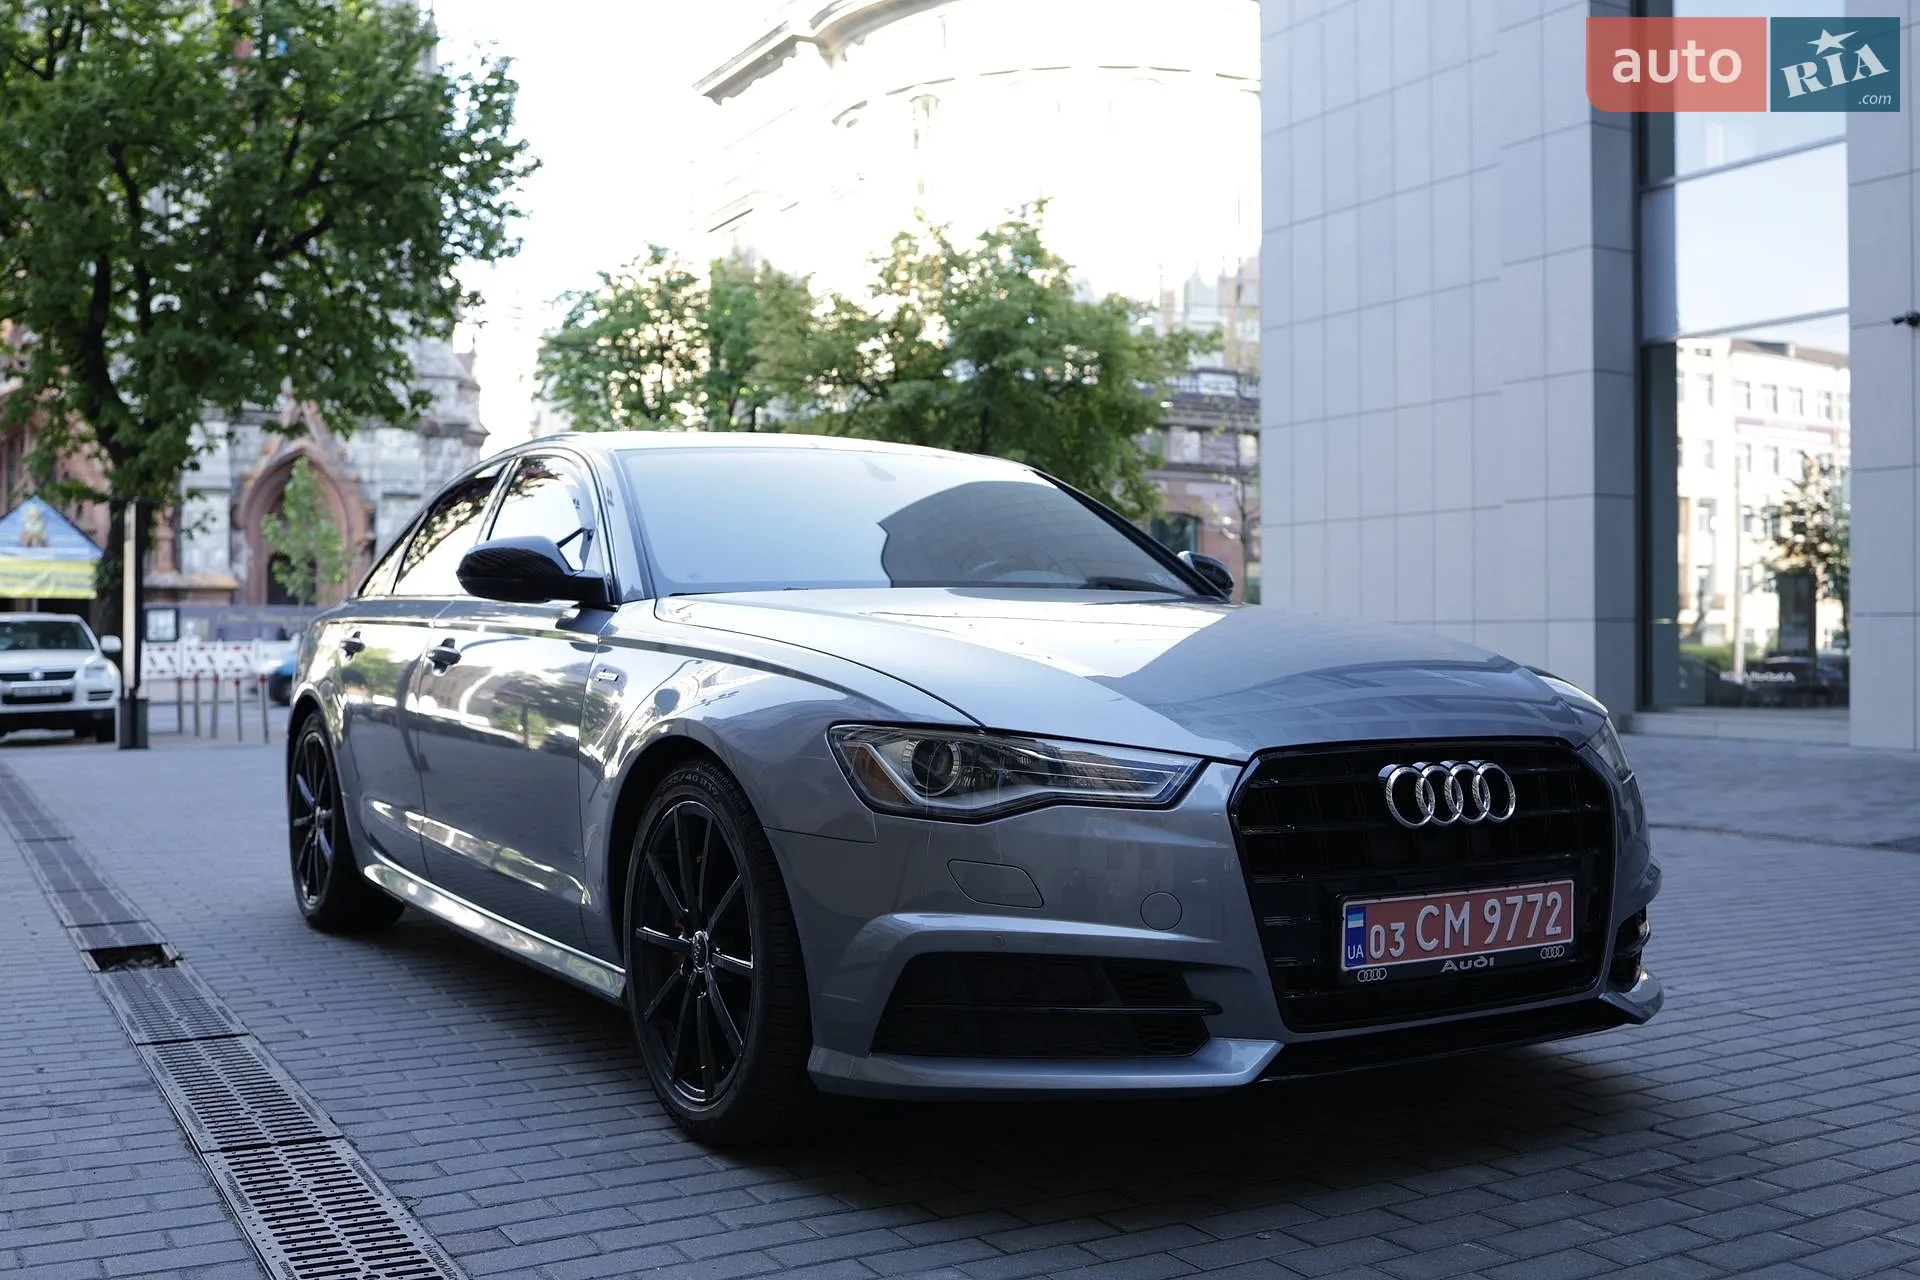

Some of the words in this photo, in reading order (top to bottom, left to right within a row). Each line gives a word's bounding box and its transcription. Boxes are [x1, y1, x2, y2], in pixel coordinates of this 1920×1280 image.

[1369, 922, 1406, 960] 03
[1415, 901, 1471, 951] CM
[1483, 891, 1562, 945] 9772
[1347, 943, 1365, 960] UA
[1440, 956, 1495, 973] Audi
